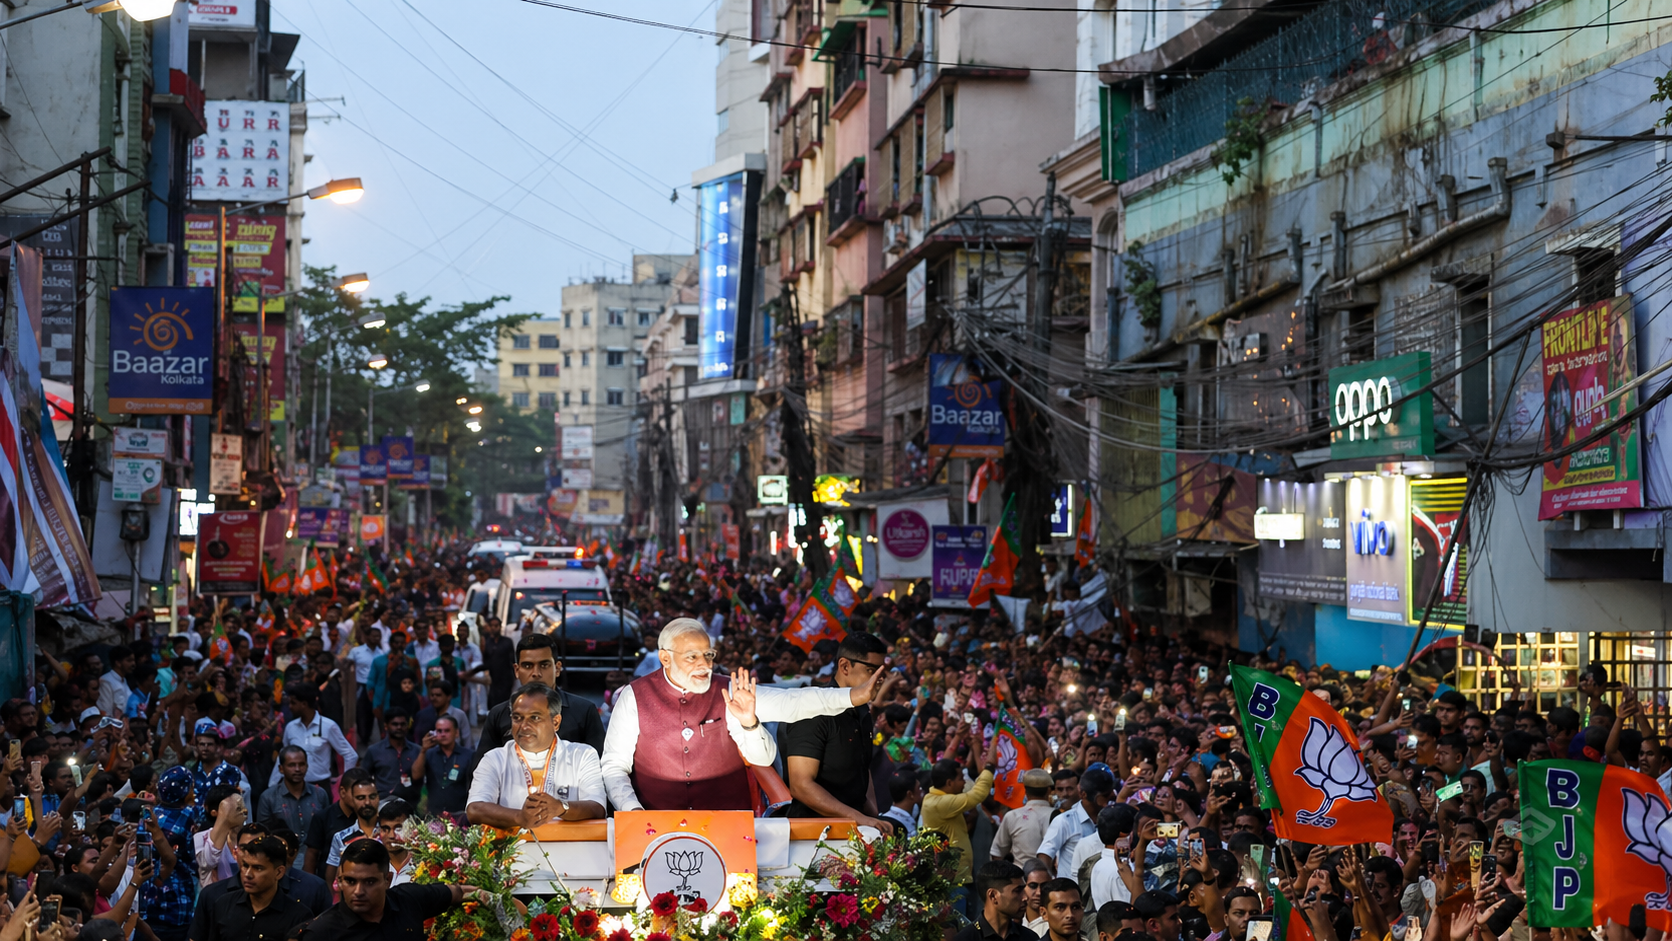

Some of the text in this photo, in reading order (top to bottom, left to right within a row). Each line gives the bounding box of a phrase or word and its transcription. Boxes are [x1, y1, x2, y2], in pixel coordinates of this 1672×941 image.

[112, 349, 209, 374] Baazar
[161, 374, 204, 385] Kolkata
[931, 404, 1002, 425] Baazar
[1335, 376, 1393, 442] oppo
[1350, 508, 1393, 556] vivo
